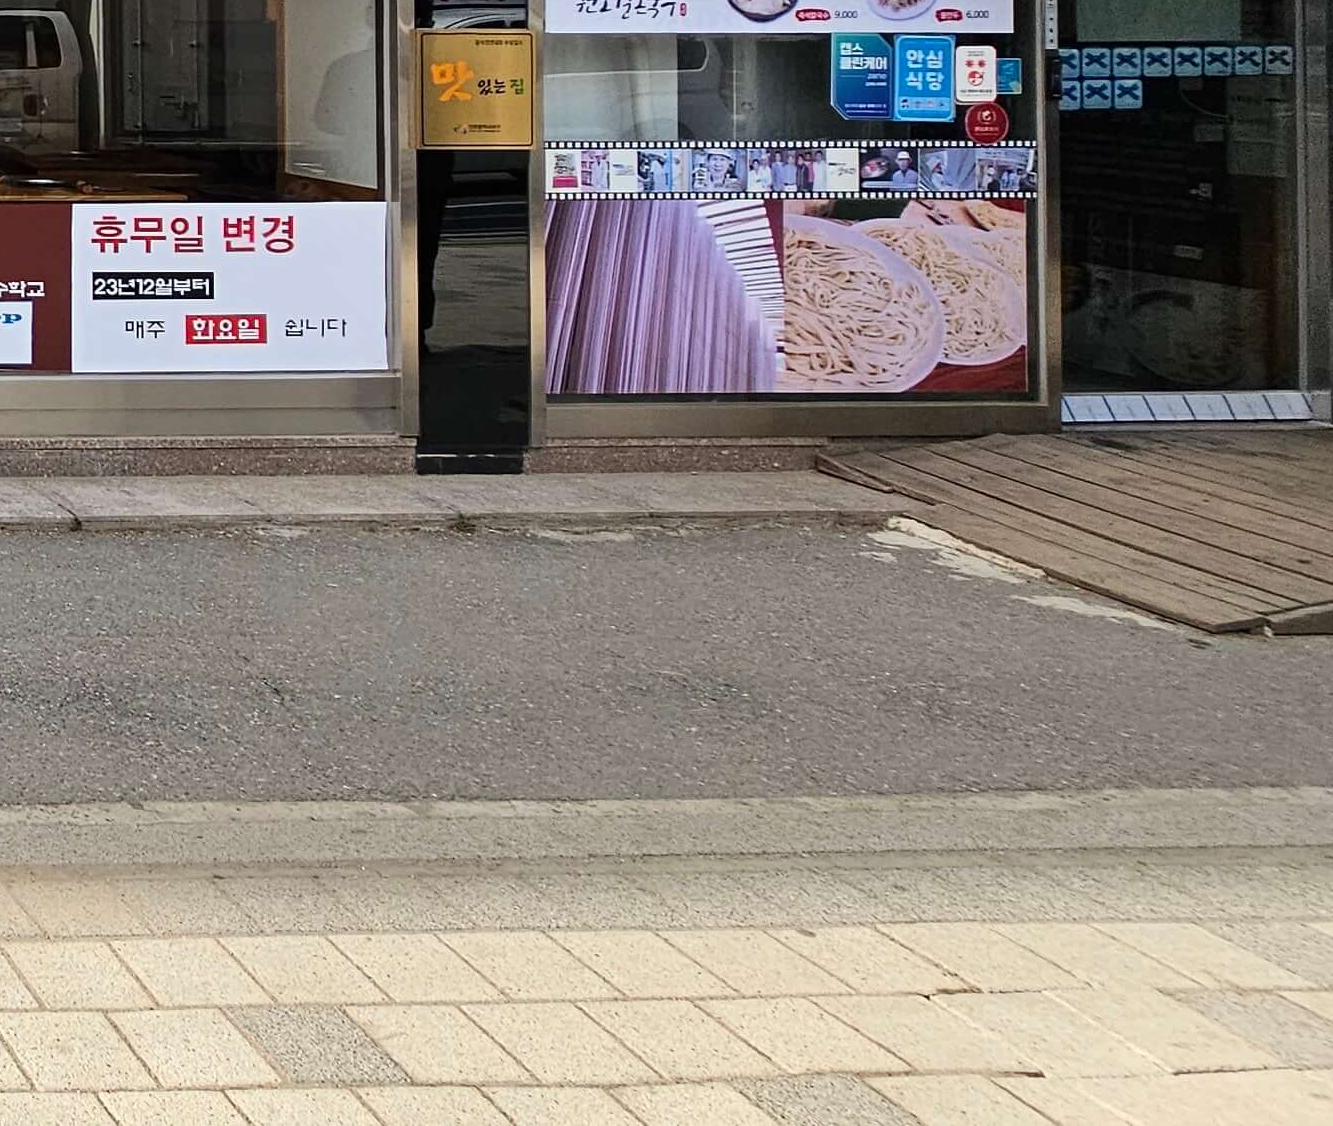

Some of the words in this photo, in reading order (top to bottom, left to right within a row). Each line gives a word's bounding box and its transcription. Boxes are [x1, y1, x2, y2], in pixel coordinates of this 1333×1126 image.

[905, 49, 944, 69] 안심
[430, 58, 474, 102] 맛
[477, 76, 506, 96] 있는
[509, 77, 524, 96] 집
[905, 71, 944, 91] 식당
[91, 215, 205, 254] 휴무일
[222, 215, 295, 254] 변경
[94, 278, 210, 297] 23년12월부터
[125, 320, 166, 339] 매주
[191, 317, 261, 341] 화요일
